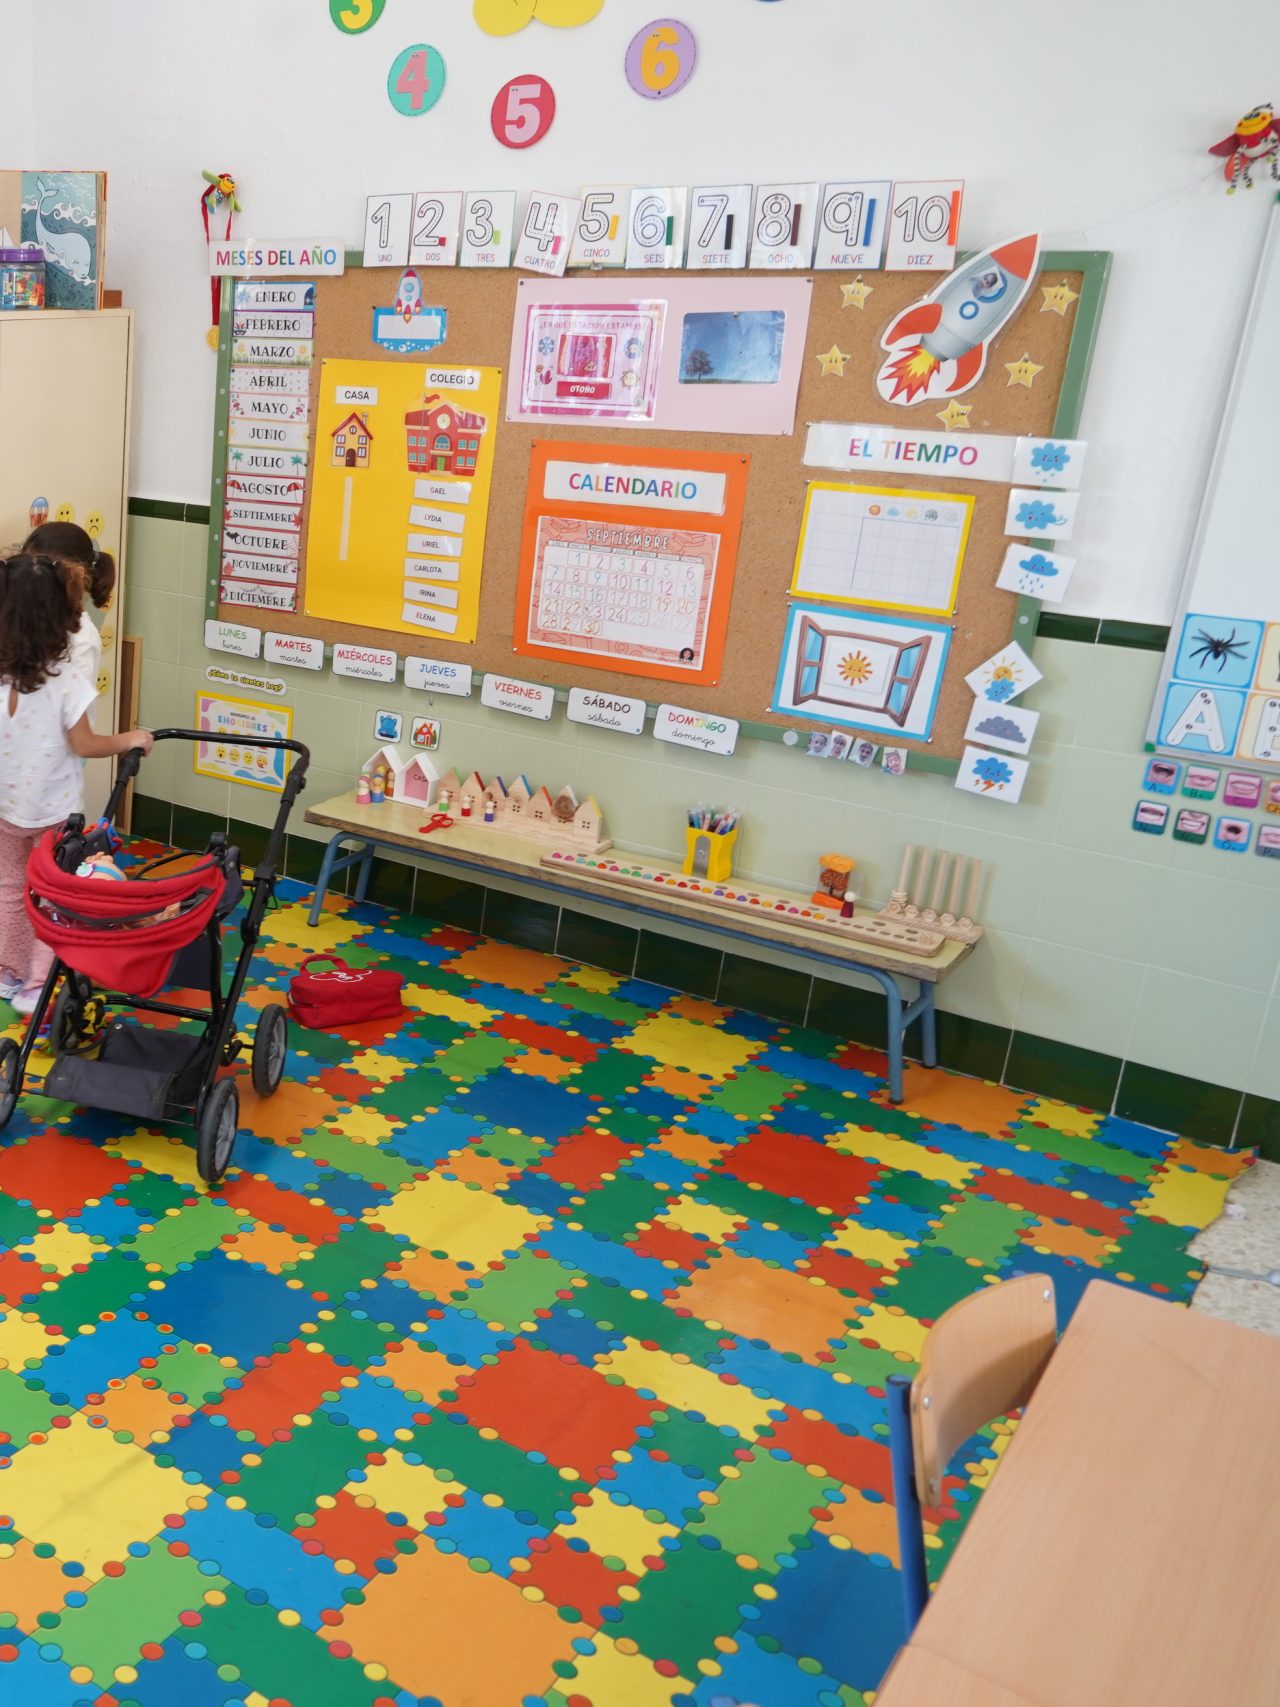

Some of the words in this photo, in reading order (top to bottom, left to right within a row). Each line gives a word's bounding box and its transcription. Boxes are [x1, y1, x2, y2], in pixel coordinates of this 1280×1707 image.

[641, 26, 680, 91] 6
[396, 51, 430, 110] 4
[504, 84, 542, 144] 5
[413, 200, 444, 247] 2
[466, 199, 494, 247] 3
[579, 193, 614, 242] 5
[633, 196, 667, 247] 6
[698, 194, 729, 247] 7
[757, 193, 791, 247] 8
[824, 191, 864, 247] 9
[894, 195, 952, 242] 10
[371, 202, 391, 248] 1
[524, 202, 558, 252] 4
[216, 250, 263, 265] MESES
[268, 250, 295, 265] DEL
[300, 246, 336, 265] AÑO
[378, 254, 393, 262] UNO
[425, 253, 441, 261] DOS
[476, 253, 495, 262] TRES
[583, 248, 611, 258] CINCO
[644, 254, 665, 264] SEIS
[702, 254, 730, 264] SIETE
[768, 253, 793, 264] OCHO
[831, 254, 864, 264] NUEVE
[907, 254, 933, 265] DIEZ
[524, 255, 556, 269] CUATRO
[255, 291, 296, 303] ENERO
[245, 319, 301, 331] FEBRERO
[250, 346, 295, 358] MARZO
[249, 376, 287, 388] ABRIL
[430, 373, 474, 385] COLEGIO
[344, 390, 369, 400] CASA
[570, 385, 595, 394] OTOÑO
[251, 402, 288, 414] MAYO
[249, 428, 286, 441] JUNIO
[849, 438, 872, 457] EL
[883, 440, 978, 466] TIEMPO
[248, 456, 285, 469] JULIO
[239, 482, 288, 497] AGOSTO
[430, 487, 446, 495] GAEL
[569, 473, 697, 499] CALENDARIO
[233, 509, 293, 523] SEPTIEMBRE
[424, 514, 442, 523] LYDIA
[234, 534, 288, 550] OCTUBRE
[422, 541, 440, 549] URIEL
[587, 528, 670, 550] SEPTIEMBRE
[232, 559, 289, 574] NOVIEMBRE
[414, 564, 442, 574] CARLOTA
[575, 552, 581, 566] 1
[596, 556, 604, 569] 2
[619, 558, 626, 571] 3
[641, 560, 648, 575] 4
[663, 563, 671, 577] 5
[686, 566, 695, 581] 6
[572, 568, 580, 583] 8
[594, 571, 602, 585] 9
[613, 573, 628, 590] 10
[636, 577, 651, 593] 11
[658, 580, 673, 596] 12
[681, 583, 697, 599] 13
[230, 591, 286, 607] DICIEMBRE
[419, 589, 436, 598] IRINA
[547, 582, 561, 596] 14
[590, 588, 604, 603] 16
[610, 591, 624, 605] 17
[633, 594, 648, 608] 18
[544, 598, 560, 612] 21
[565, 601, 581, 615] 22
[608, 607, 624, 622] 24
[416, 612, 436, 623] ELENA
[219, 627, 247, 640] LUNES
[222, 640, 242, 651] lunes
[275, 639, 312, 652] MARTES
[280, 654, 307, 664] martes
[337, 648, 393, 665] MIÉRCOLES
[345, 665, 383, 677] miércoles
[419, 664, 456, 677] JUEVES
[208, 669, 229, 680] ¿Cómo
[231, 674, 239, 682] te
[240, 677, 265, 689] sientes
[266, 682, 283, 692] hoy?
[424, 680, 450, 689] jueves
[494, 681, 542, 700] VIERNES
[499, 699, 533, 713] viernes
[583, 694, 631, 714] SÁBADO
[218, 715, 268, 733] EMOCIONES
[588, 713, 621, 727] sábado
[668, 712, 727, 734] DOMINGO
[1166, 689, 1225, 753] A
[672, 729, 715, 747] domingo
